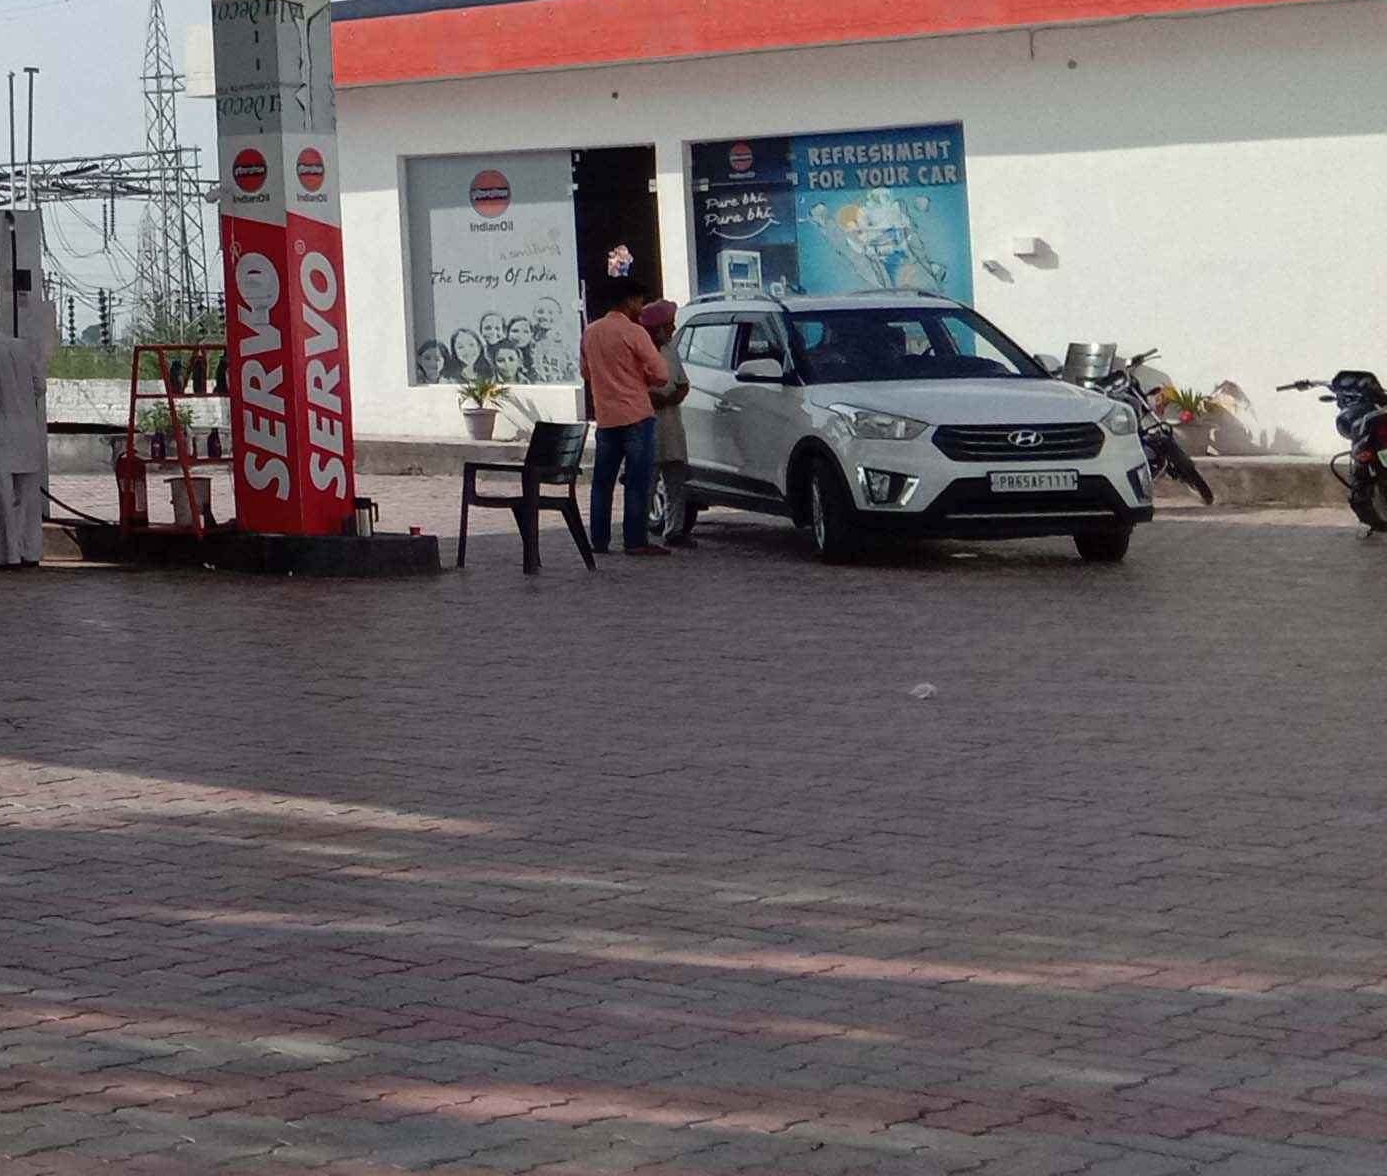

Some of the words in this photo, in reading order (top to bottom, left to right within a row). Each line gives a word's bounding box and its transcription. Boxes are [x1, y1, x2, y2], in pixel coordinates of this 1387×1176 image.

[808, 140, 951, 167] REFRESHMENT
[808, 171, 845, 190] FOR
[857, 167, 910, 188] YOUR
[918, 165, 959, 185] CAR
[469, 220, 514, 233] IndianOil
[430, 268, 452, 285] The
[458, 270, 500, 289] Energy
[505, 266, 523, 286] Of
[525, 265, 557, 283] India
[300, 251, 347, 500] SERVO
